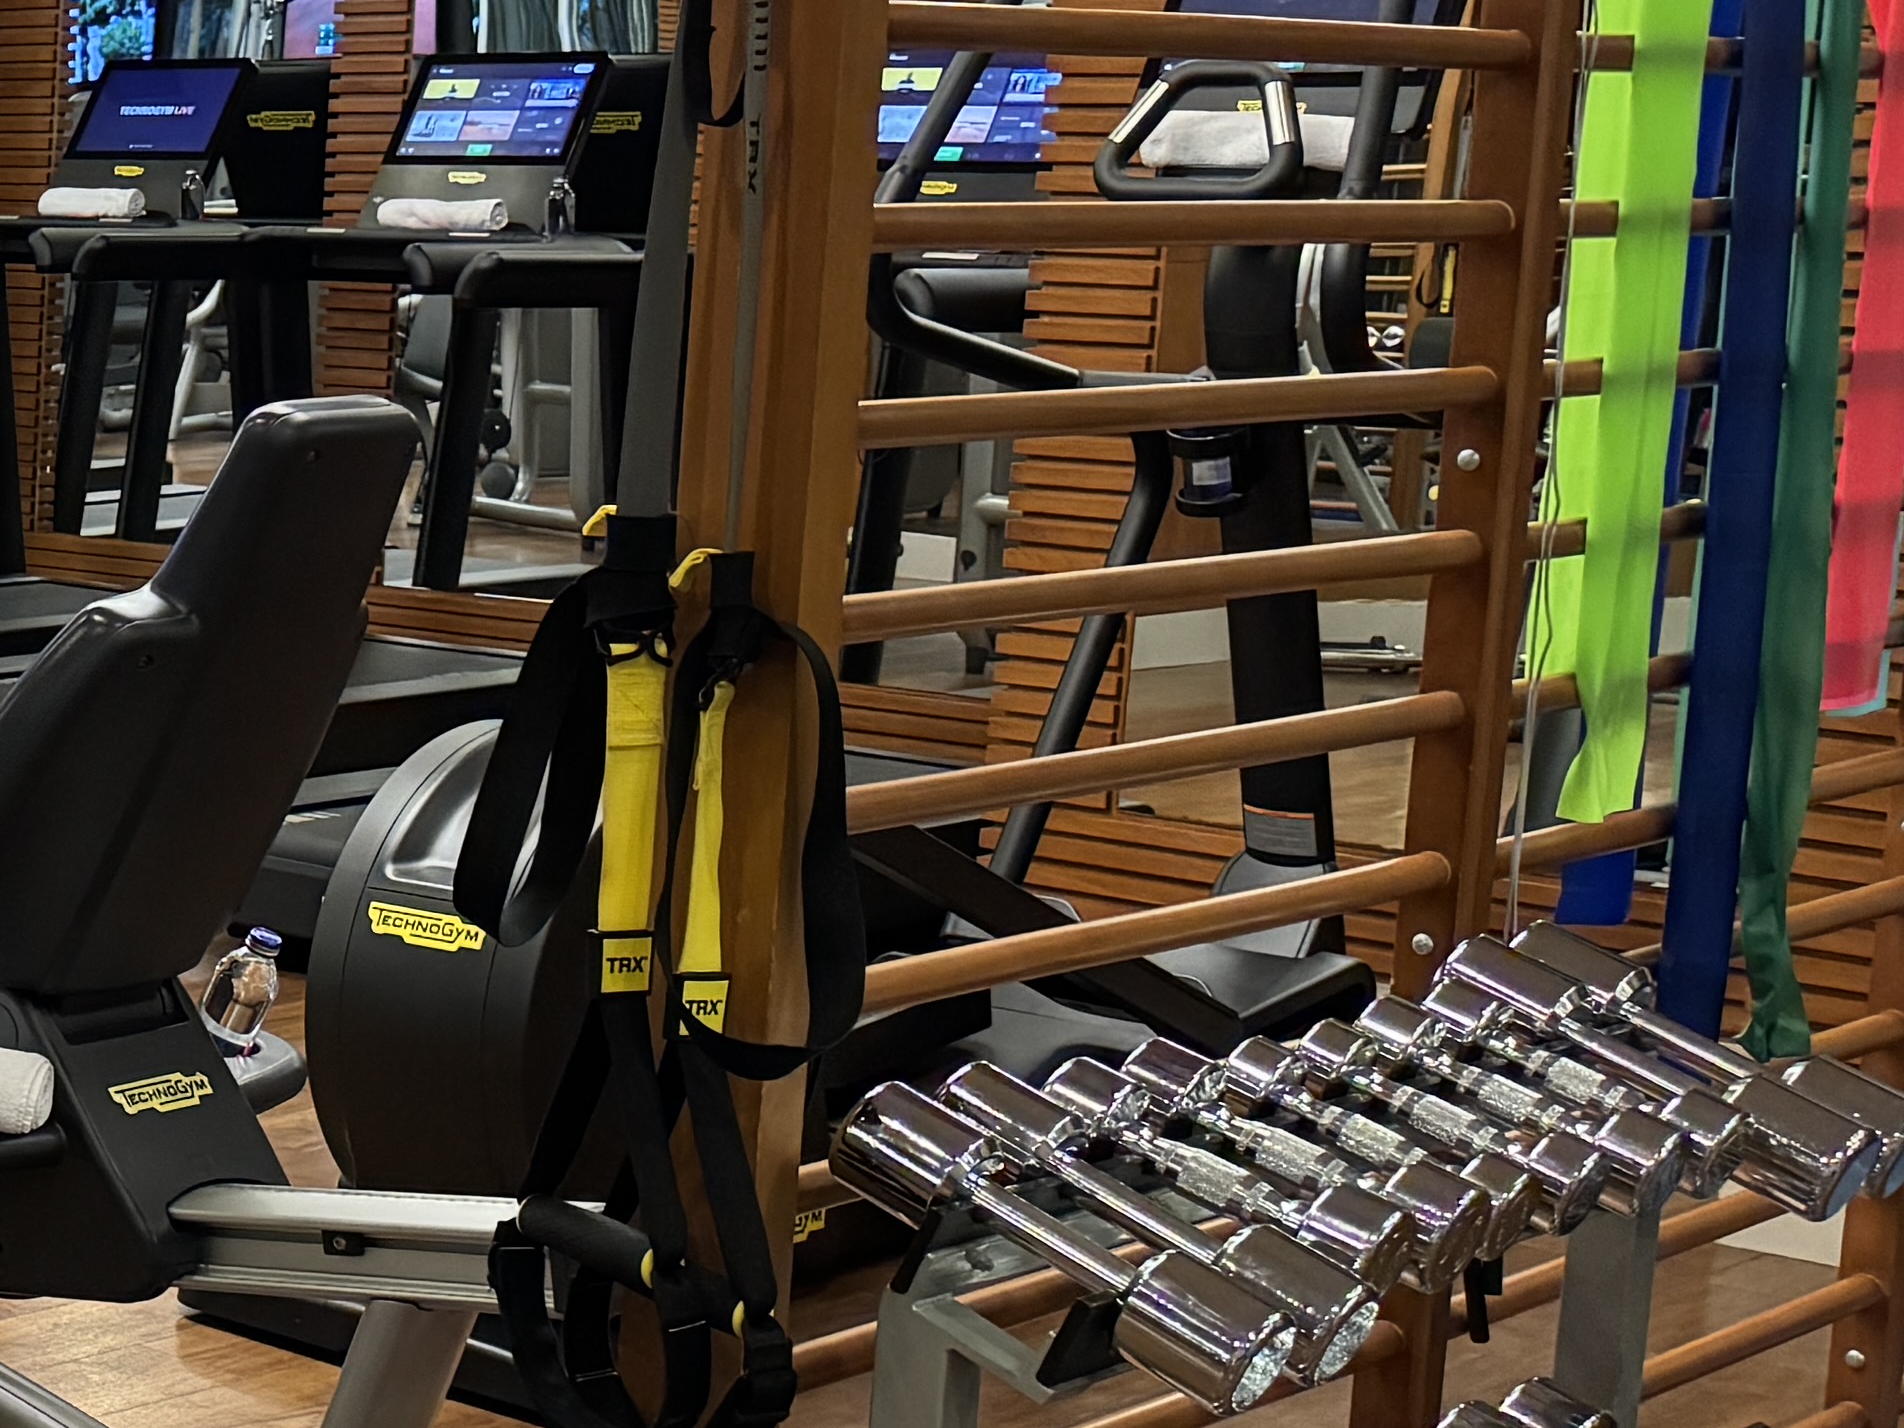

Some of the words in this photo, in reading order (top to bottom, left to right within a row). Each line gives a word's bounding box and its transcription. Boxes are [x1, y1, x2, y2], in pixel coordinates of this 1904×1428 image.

[372, 906, 479, 944] TECHNOGYM
[606, 956, 647, 974] TRX
[114, 1079, 208, 1108] TECHNOGYM
